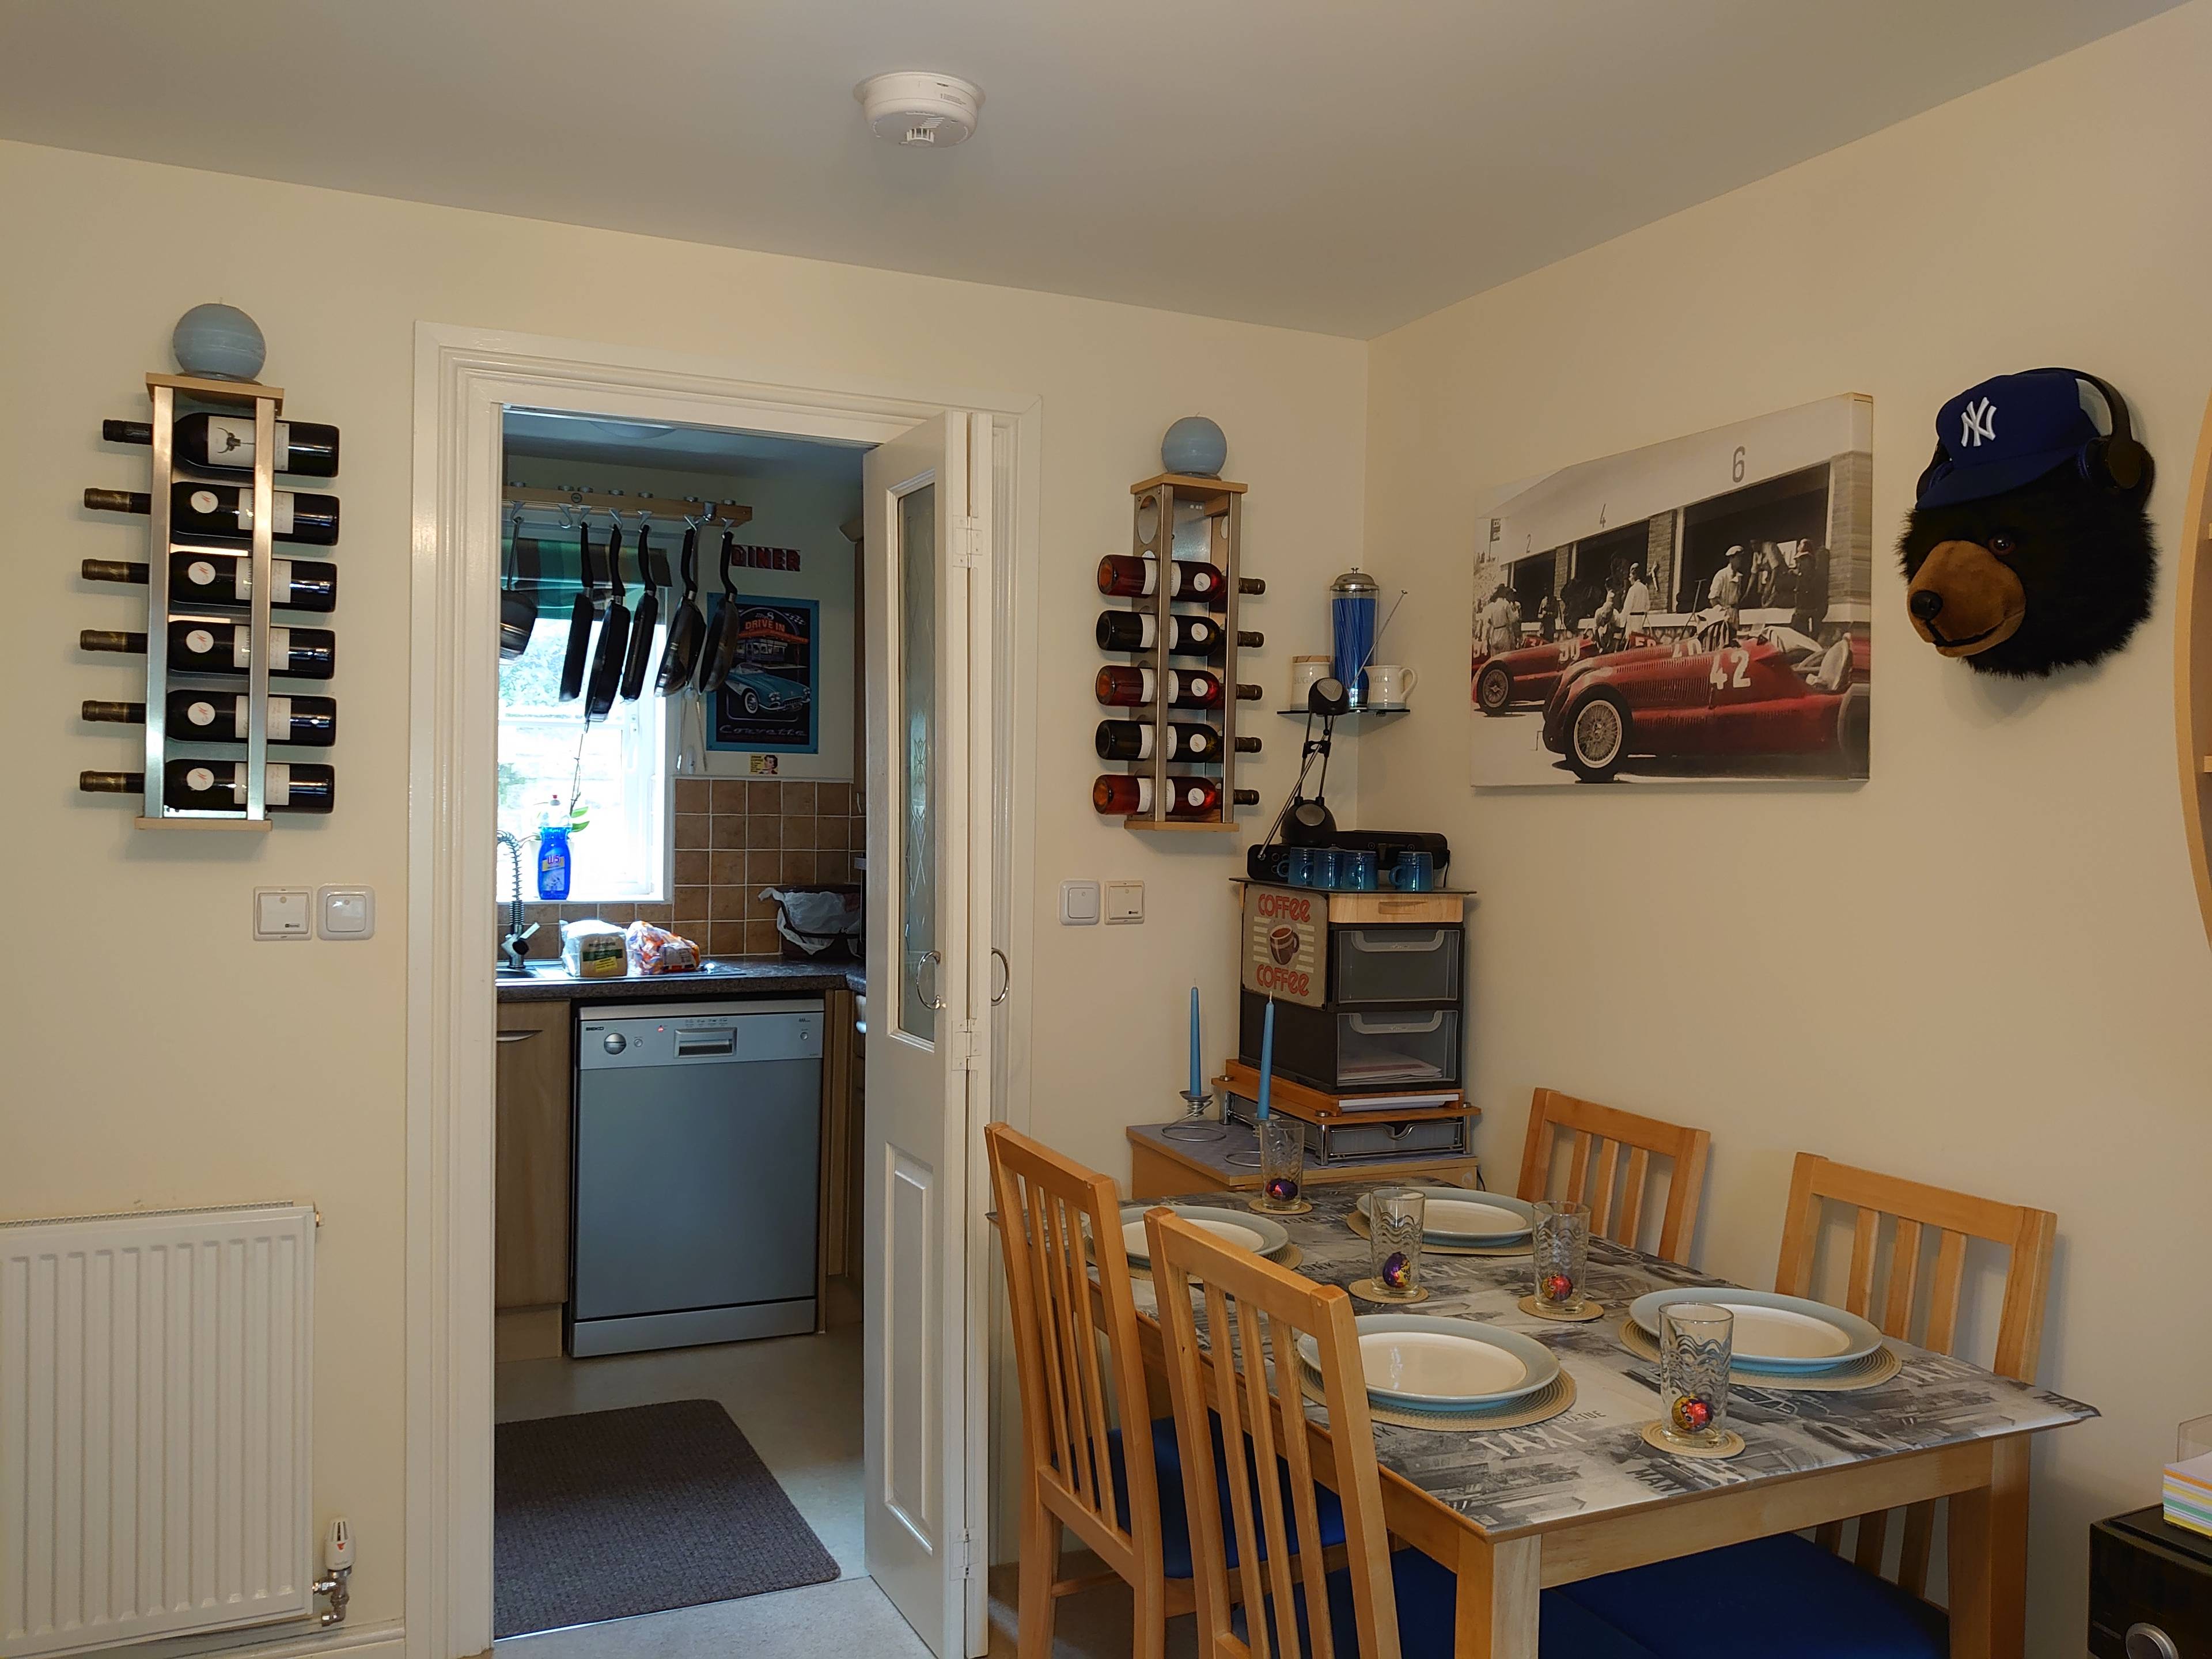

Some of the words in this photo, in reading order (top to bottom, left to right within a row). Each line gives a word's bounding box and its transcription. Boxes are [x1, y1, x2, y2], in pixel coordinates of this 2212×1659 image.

[1960, 396, 1997, 448] NY
[1732, 445, 1746, 483] 6
[1599, 503, 1607, 528] 4
[1526, 533, 1532, 554] 2
[732, 544, 801, 572] DINER
[745, 619, 774, 630] DRIVE
[775, 622, 786, 632] IN
[1294, 676, 1319, 685] SUGA
[1710, 649, 1751, 690] 42
[719, 724, 807, 737] Corvette
[1554, 1410, 1608, 1425] STATUE
[1468, 1425, 1588, 1457] TAXI
